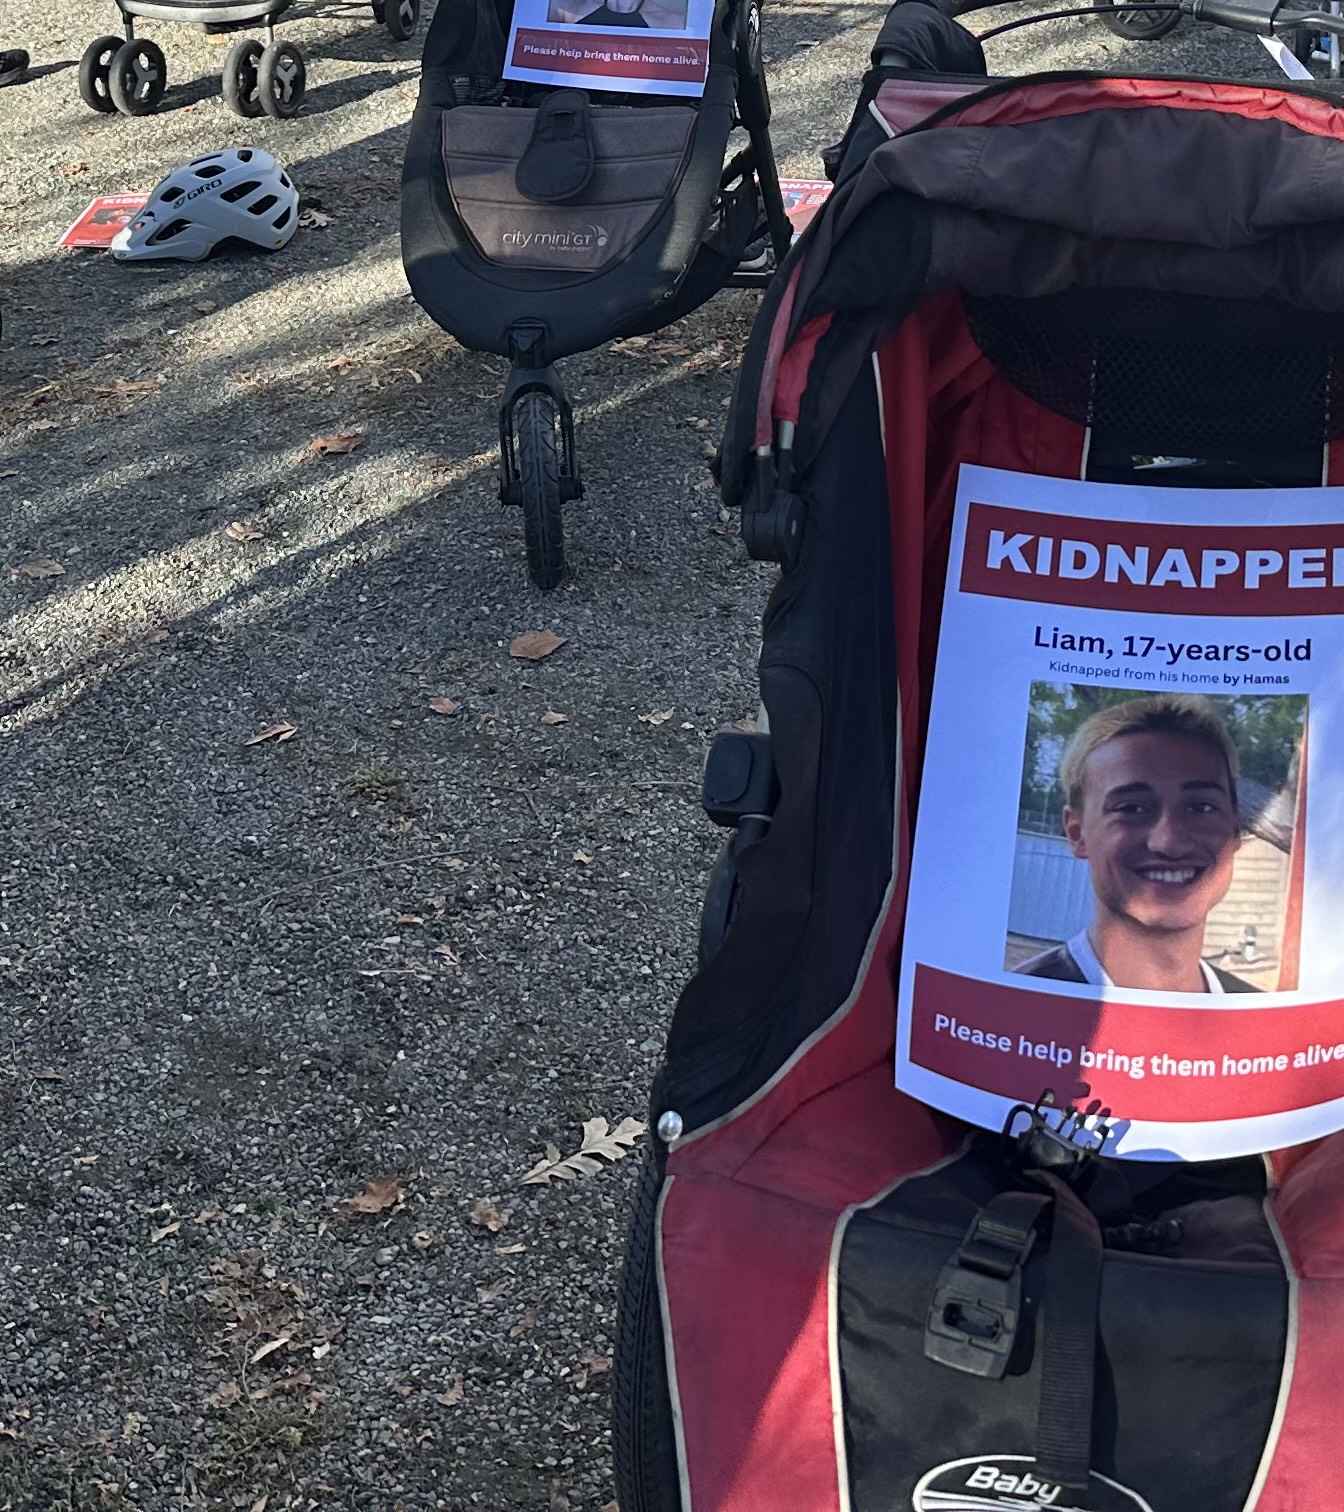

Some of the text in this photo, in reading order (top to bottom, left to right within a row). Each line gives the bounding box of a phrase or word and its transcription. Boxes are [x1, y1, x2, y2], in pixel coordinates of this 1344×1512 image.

[522, 44, 558, 57] Please
[559, 47, 583, 60] help
[584, 49, 612, 62] bring
[612, 51, 641, 62] them
[641, 53, 672, 65] home
[187, 178, 223, 201] GIRO
[502, 228, 593, 249] city mini GT
[1033, 626, 1313, 666] Liam, 17-years-old
[1048, 660, 1291, 687] Kidnapped from his home by Hamas
[934, 1013, 1013, 1052] Please
[1017, 1035, 1074, 1068] help
[1079, 1045, 1146, 1080] bring
[1150, 1053, 1217, 1078] them
[1221, 1053, 1289, 1077] home
[964, 1464, 1062, 1504] Baby
